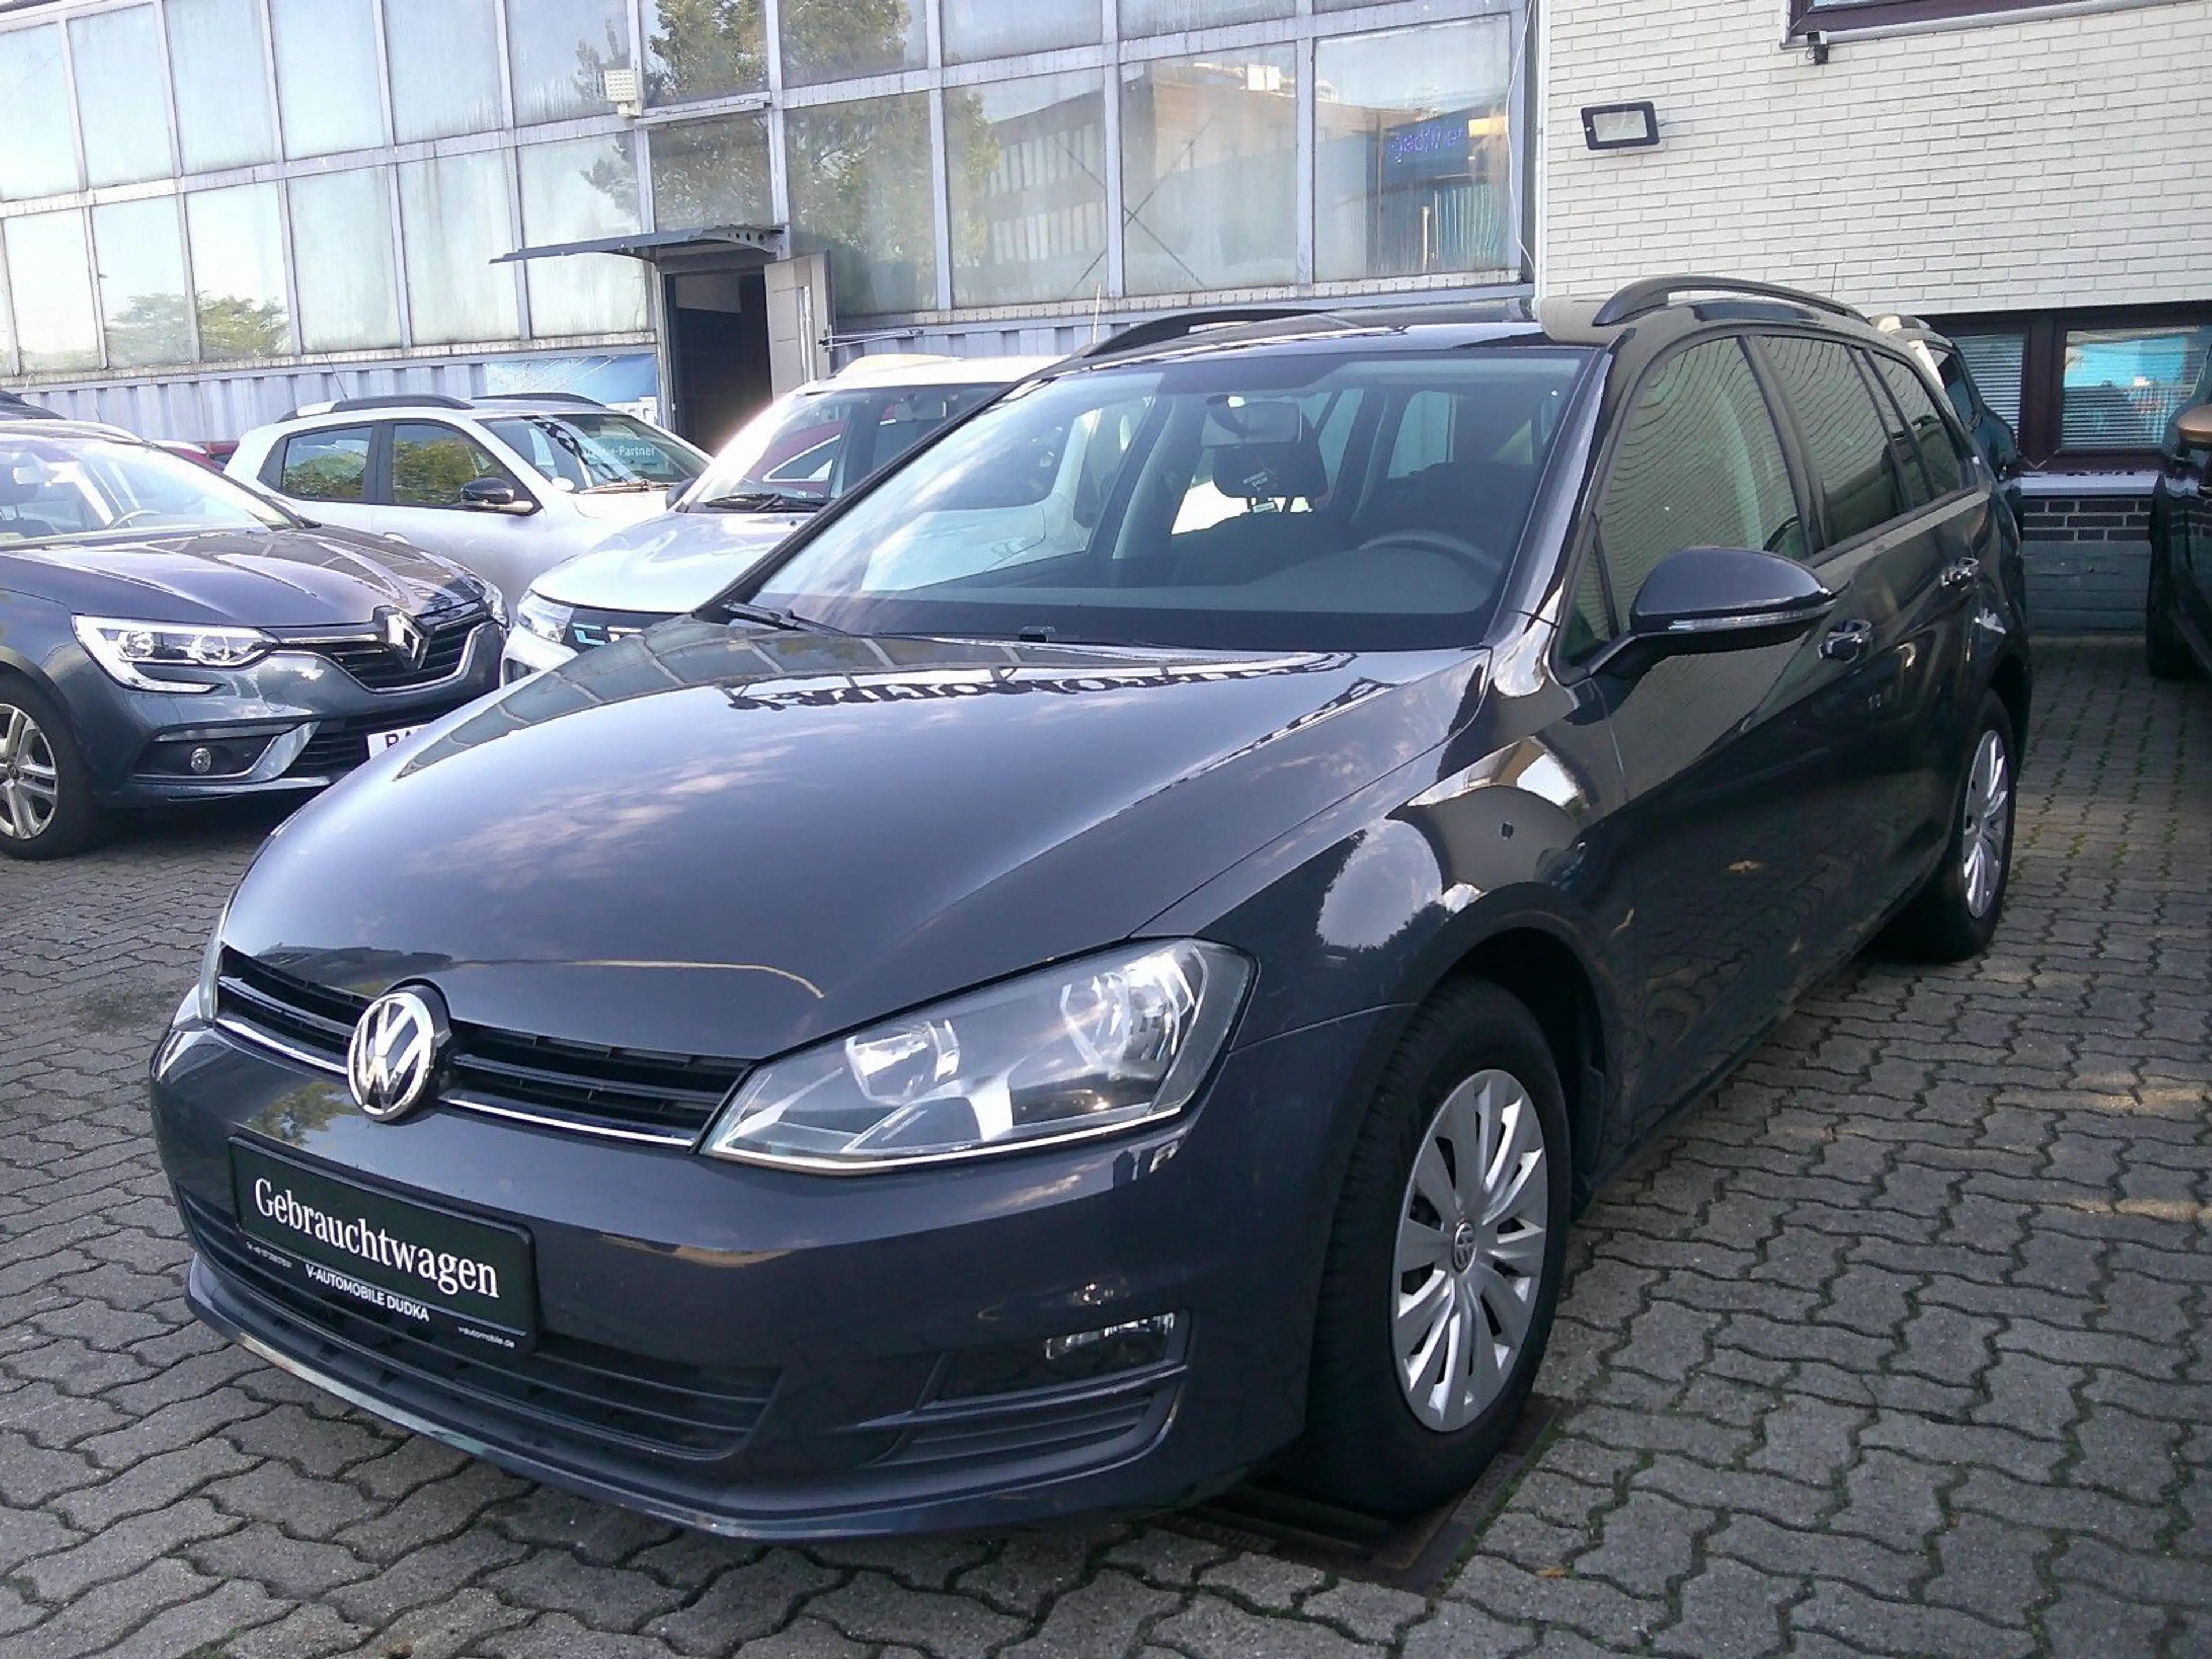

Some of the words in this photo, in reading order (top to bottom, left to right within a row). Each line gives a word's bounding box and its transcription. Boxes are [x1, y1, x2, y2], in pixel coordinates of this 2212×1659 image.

[348, 992, 434, 1119] VW
[255, 1178, 500, 1298] Gebrauchtwagen
[305, 1264, 385, 1305] V-AUTOMOBILE
[387, 1296, 430, 1323] DUDKA
